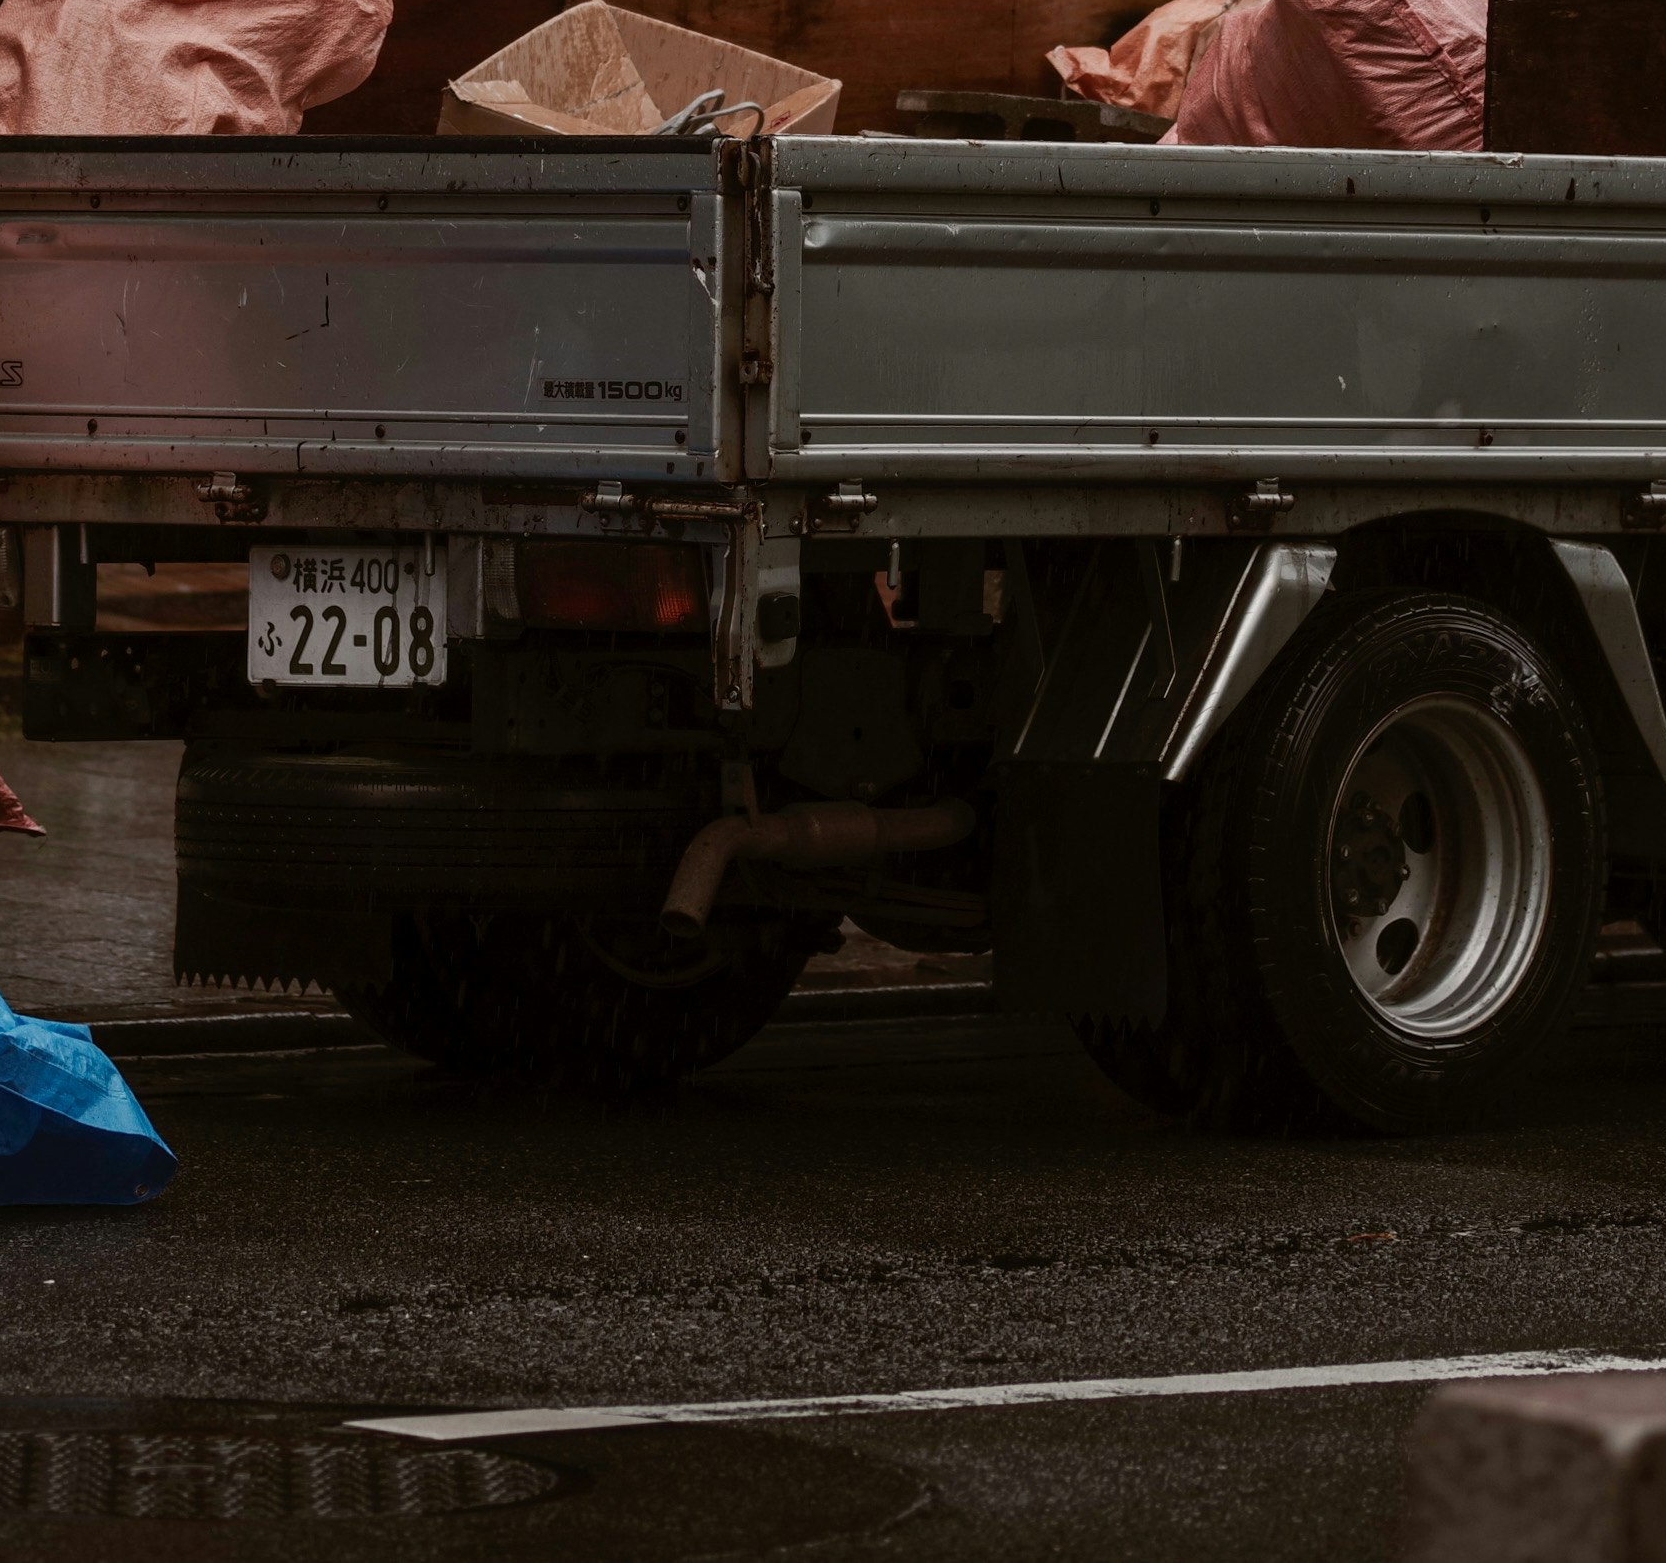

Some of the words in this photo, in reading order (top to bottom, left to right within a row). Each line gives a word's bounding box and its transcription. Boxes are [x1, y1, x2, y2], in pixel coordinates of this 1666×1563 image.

[543, 381, 595, 399] 最大積載量
[292, 558, 346, 594] 横浜
[350, 558, 400, 595] 400
[258, 621, 283, 658] ふ
[289, 605, 434, 677] 22-08
